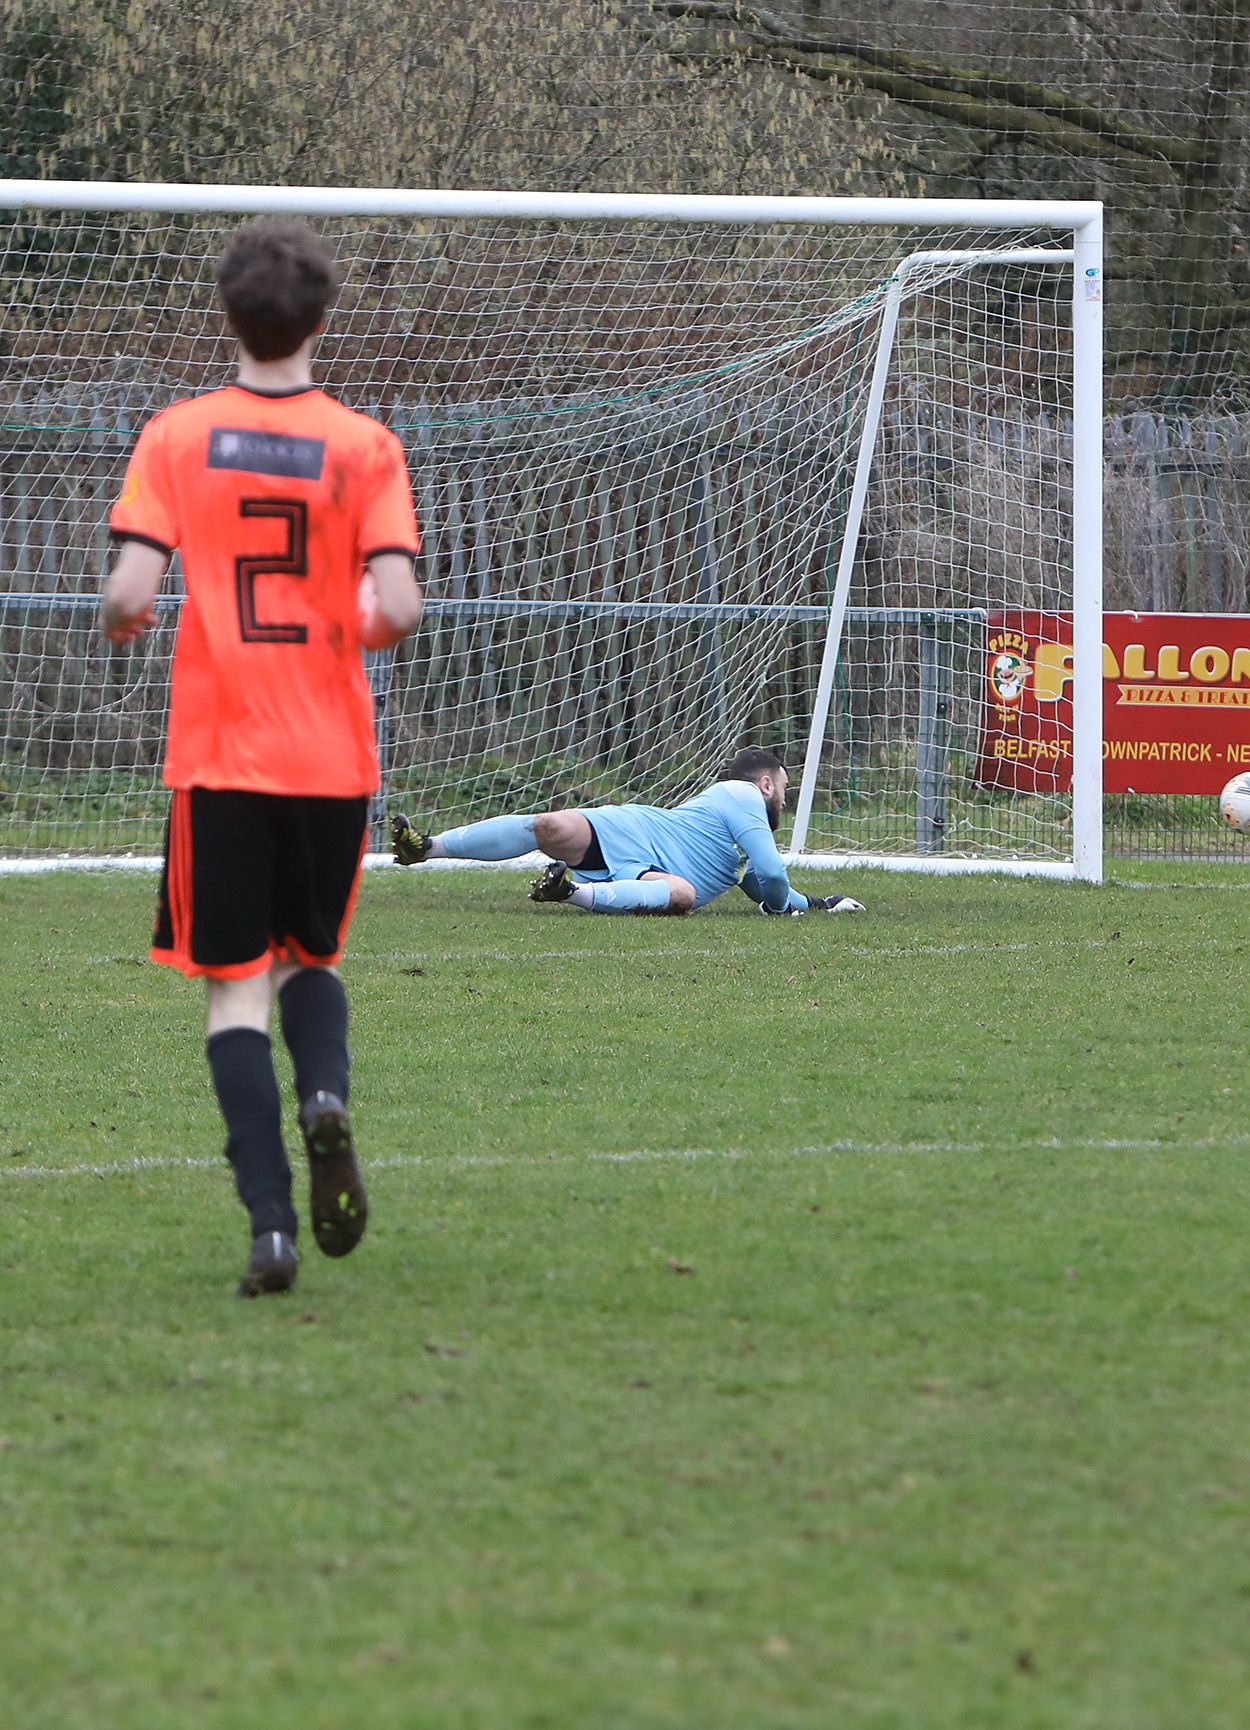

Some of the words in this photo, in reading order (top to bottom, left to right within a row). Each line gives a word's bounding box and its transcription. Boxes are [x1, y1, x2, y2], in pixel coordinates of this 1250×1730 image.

[235, 497, 308, 643] 2
[1126, 688, 1174, 702] PIZZA
[1180, 690, 1190, 702] &
[993, 738, 1071, 758] BELFAST
[1102, 740, 1212, 763] OWNPATRICK
